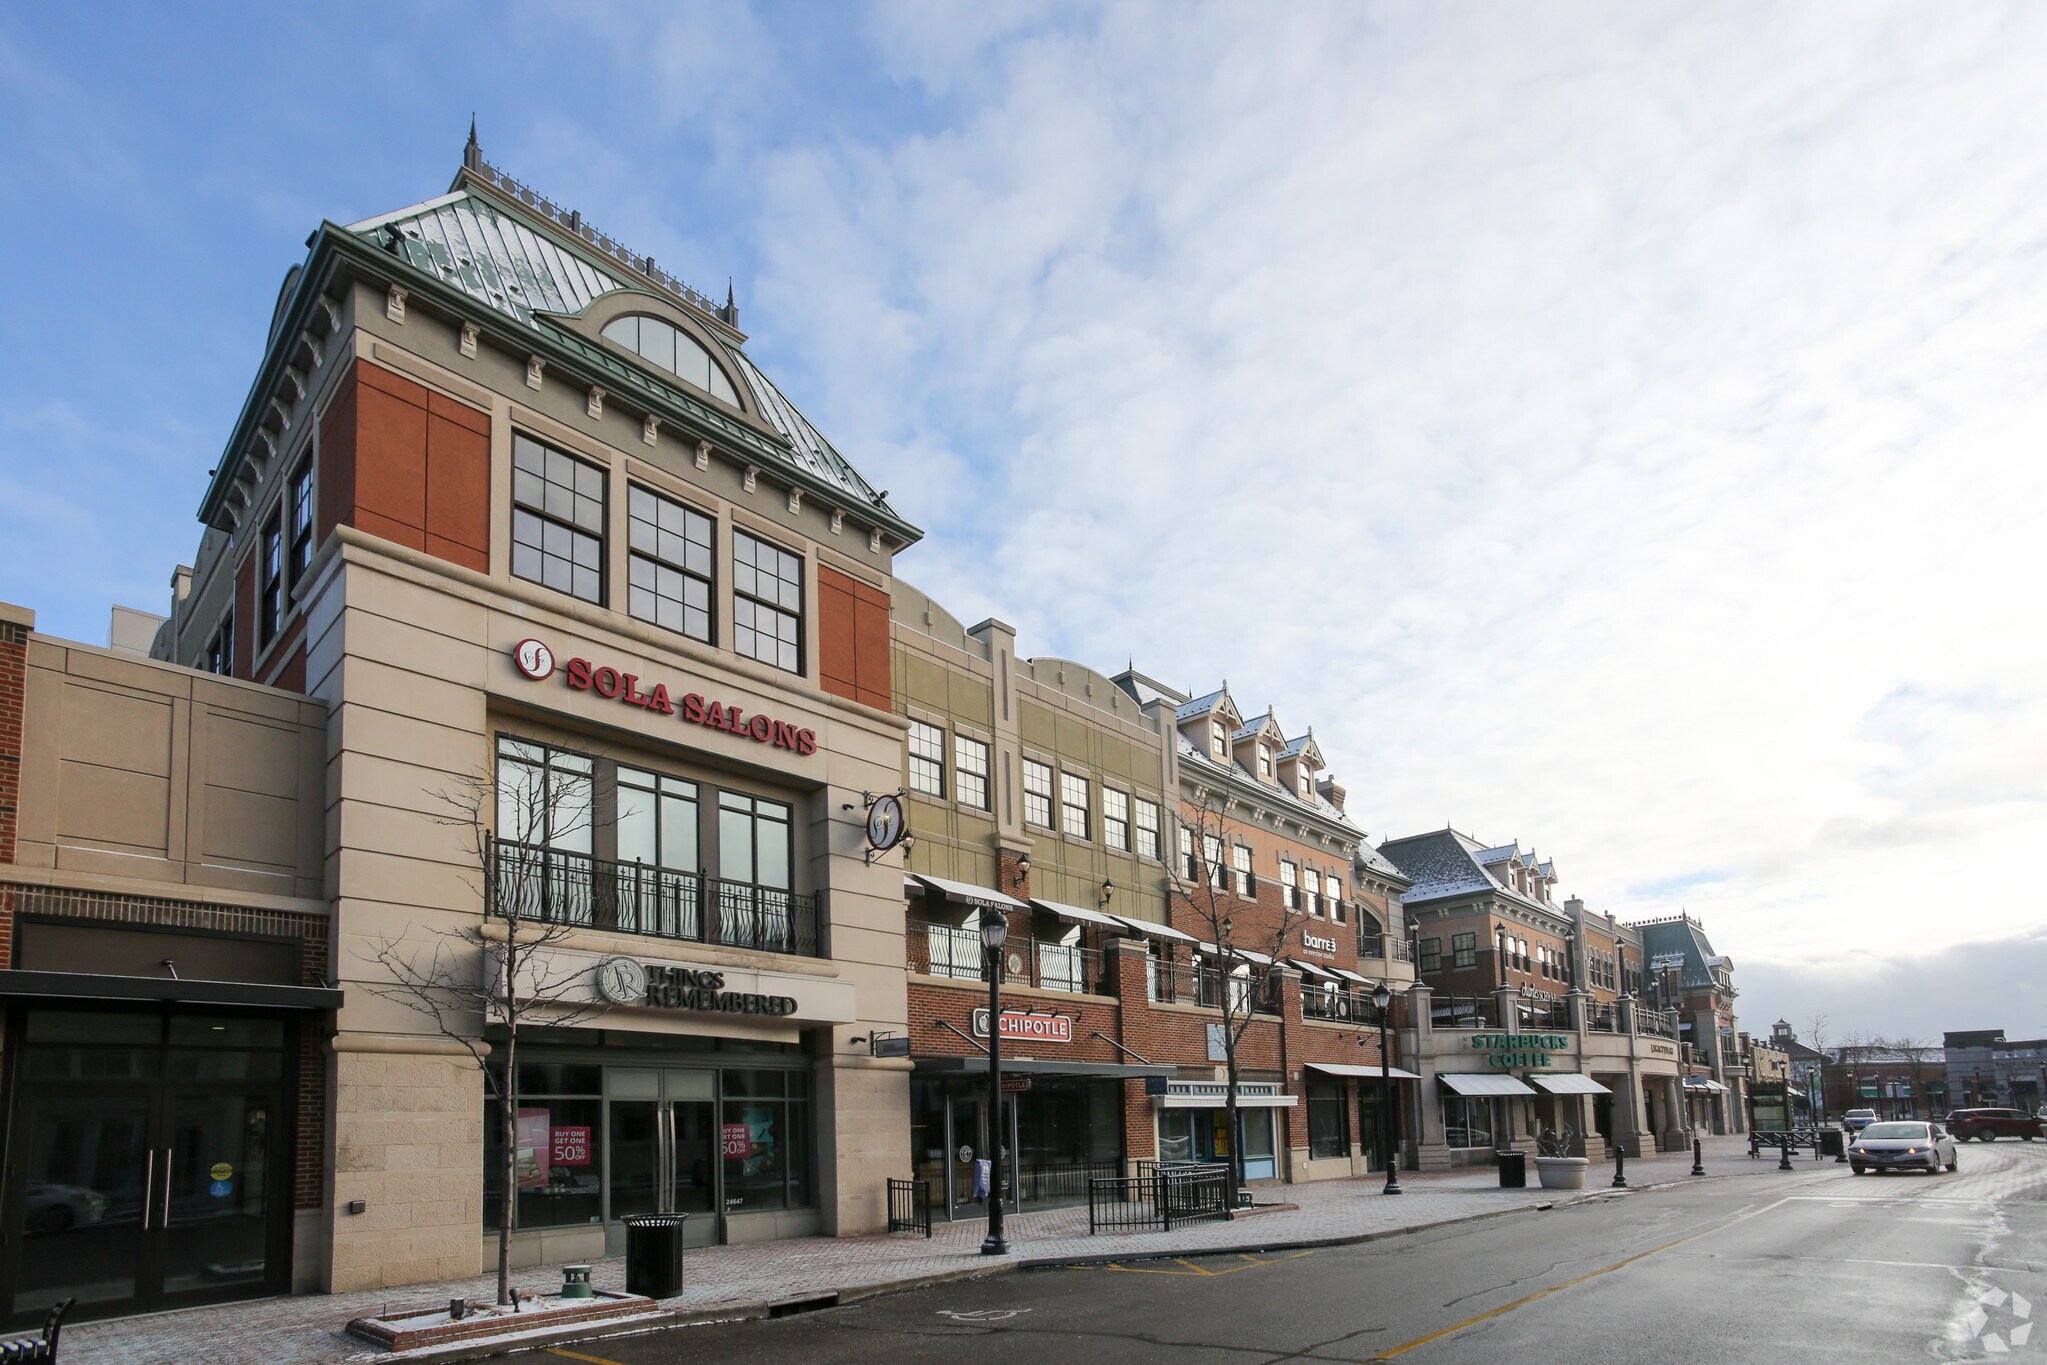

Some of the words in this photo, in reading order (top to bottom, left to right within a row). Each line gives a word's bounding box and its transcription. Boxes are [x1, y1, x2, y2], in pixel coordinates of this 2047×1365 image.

[567, 657, 674, 715] SOLA
[683, 692, 818, 756] SALONS
[974, 897, 990, 907] SOLA
[645, 965, 725, 990] THINGS
[647, 985, 798, 1016] REMEMBERED
[999, 1017, 1067, 1036] CHIPOTLE
[1471, 1034, 1569, 1050] STARBUCKS
[1489, 1053, 1552, 1067] COFFEE
[1001, 1081, 1026, 1089] HIPOTLE
